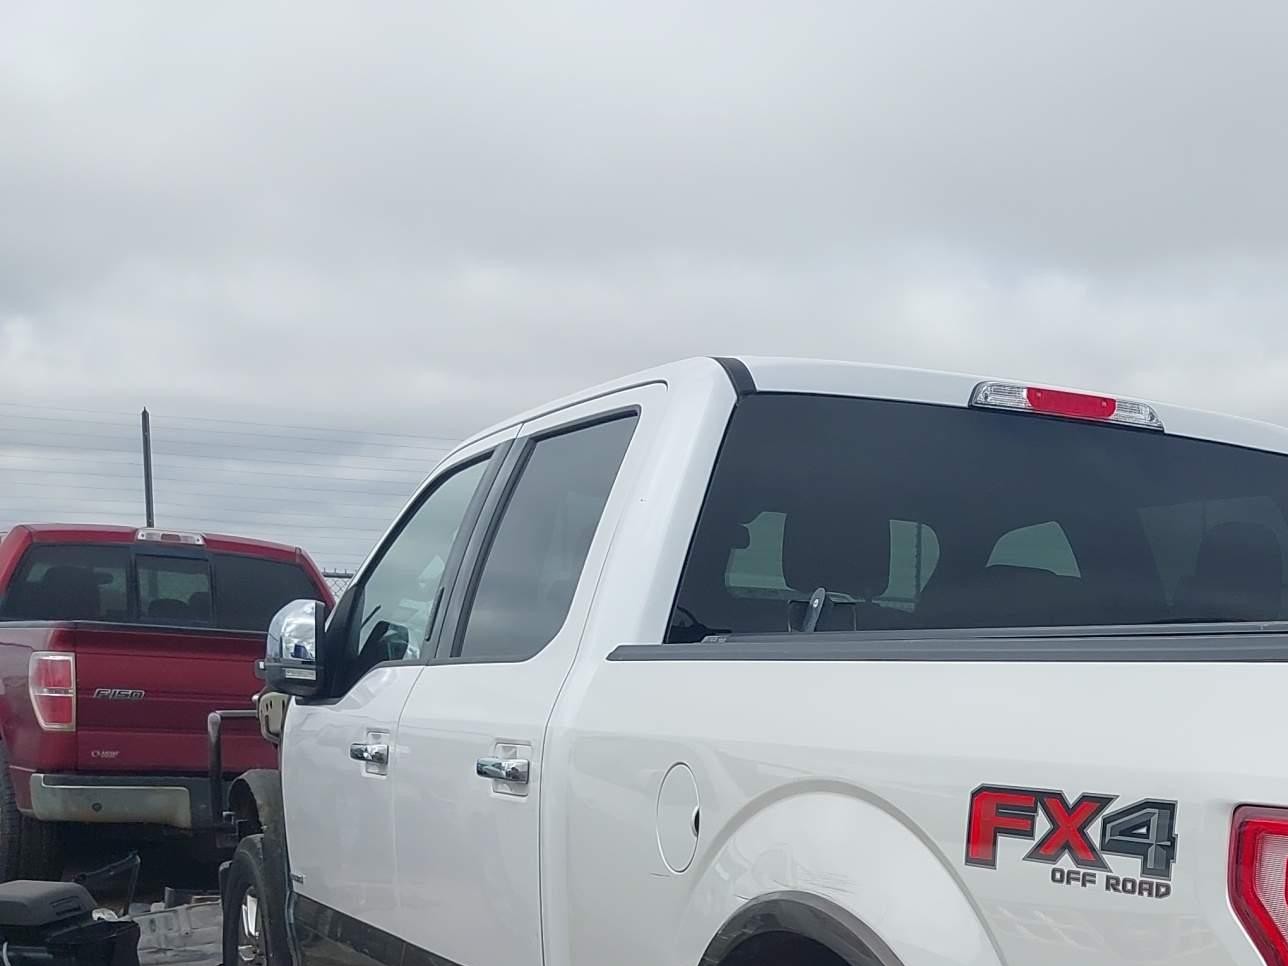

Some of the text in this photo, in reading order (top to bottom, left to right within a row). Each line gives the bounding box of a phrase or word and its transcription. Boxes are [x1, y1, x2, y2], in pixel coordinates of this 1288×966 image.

[964, 783, 1178, 881] FX4
[1050, 867, 1172, 899] OFF ROAD
